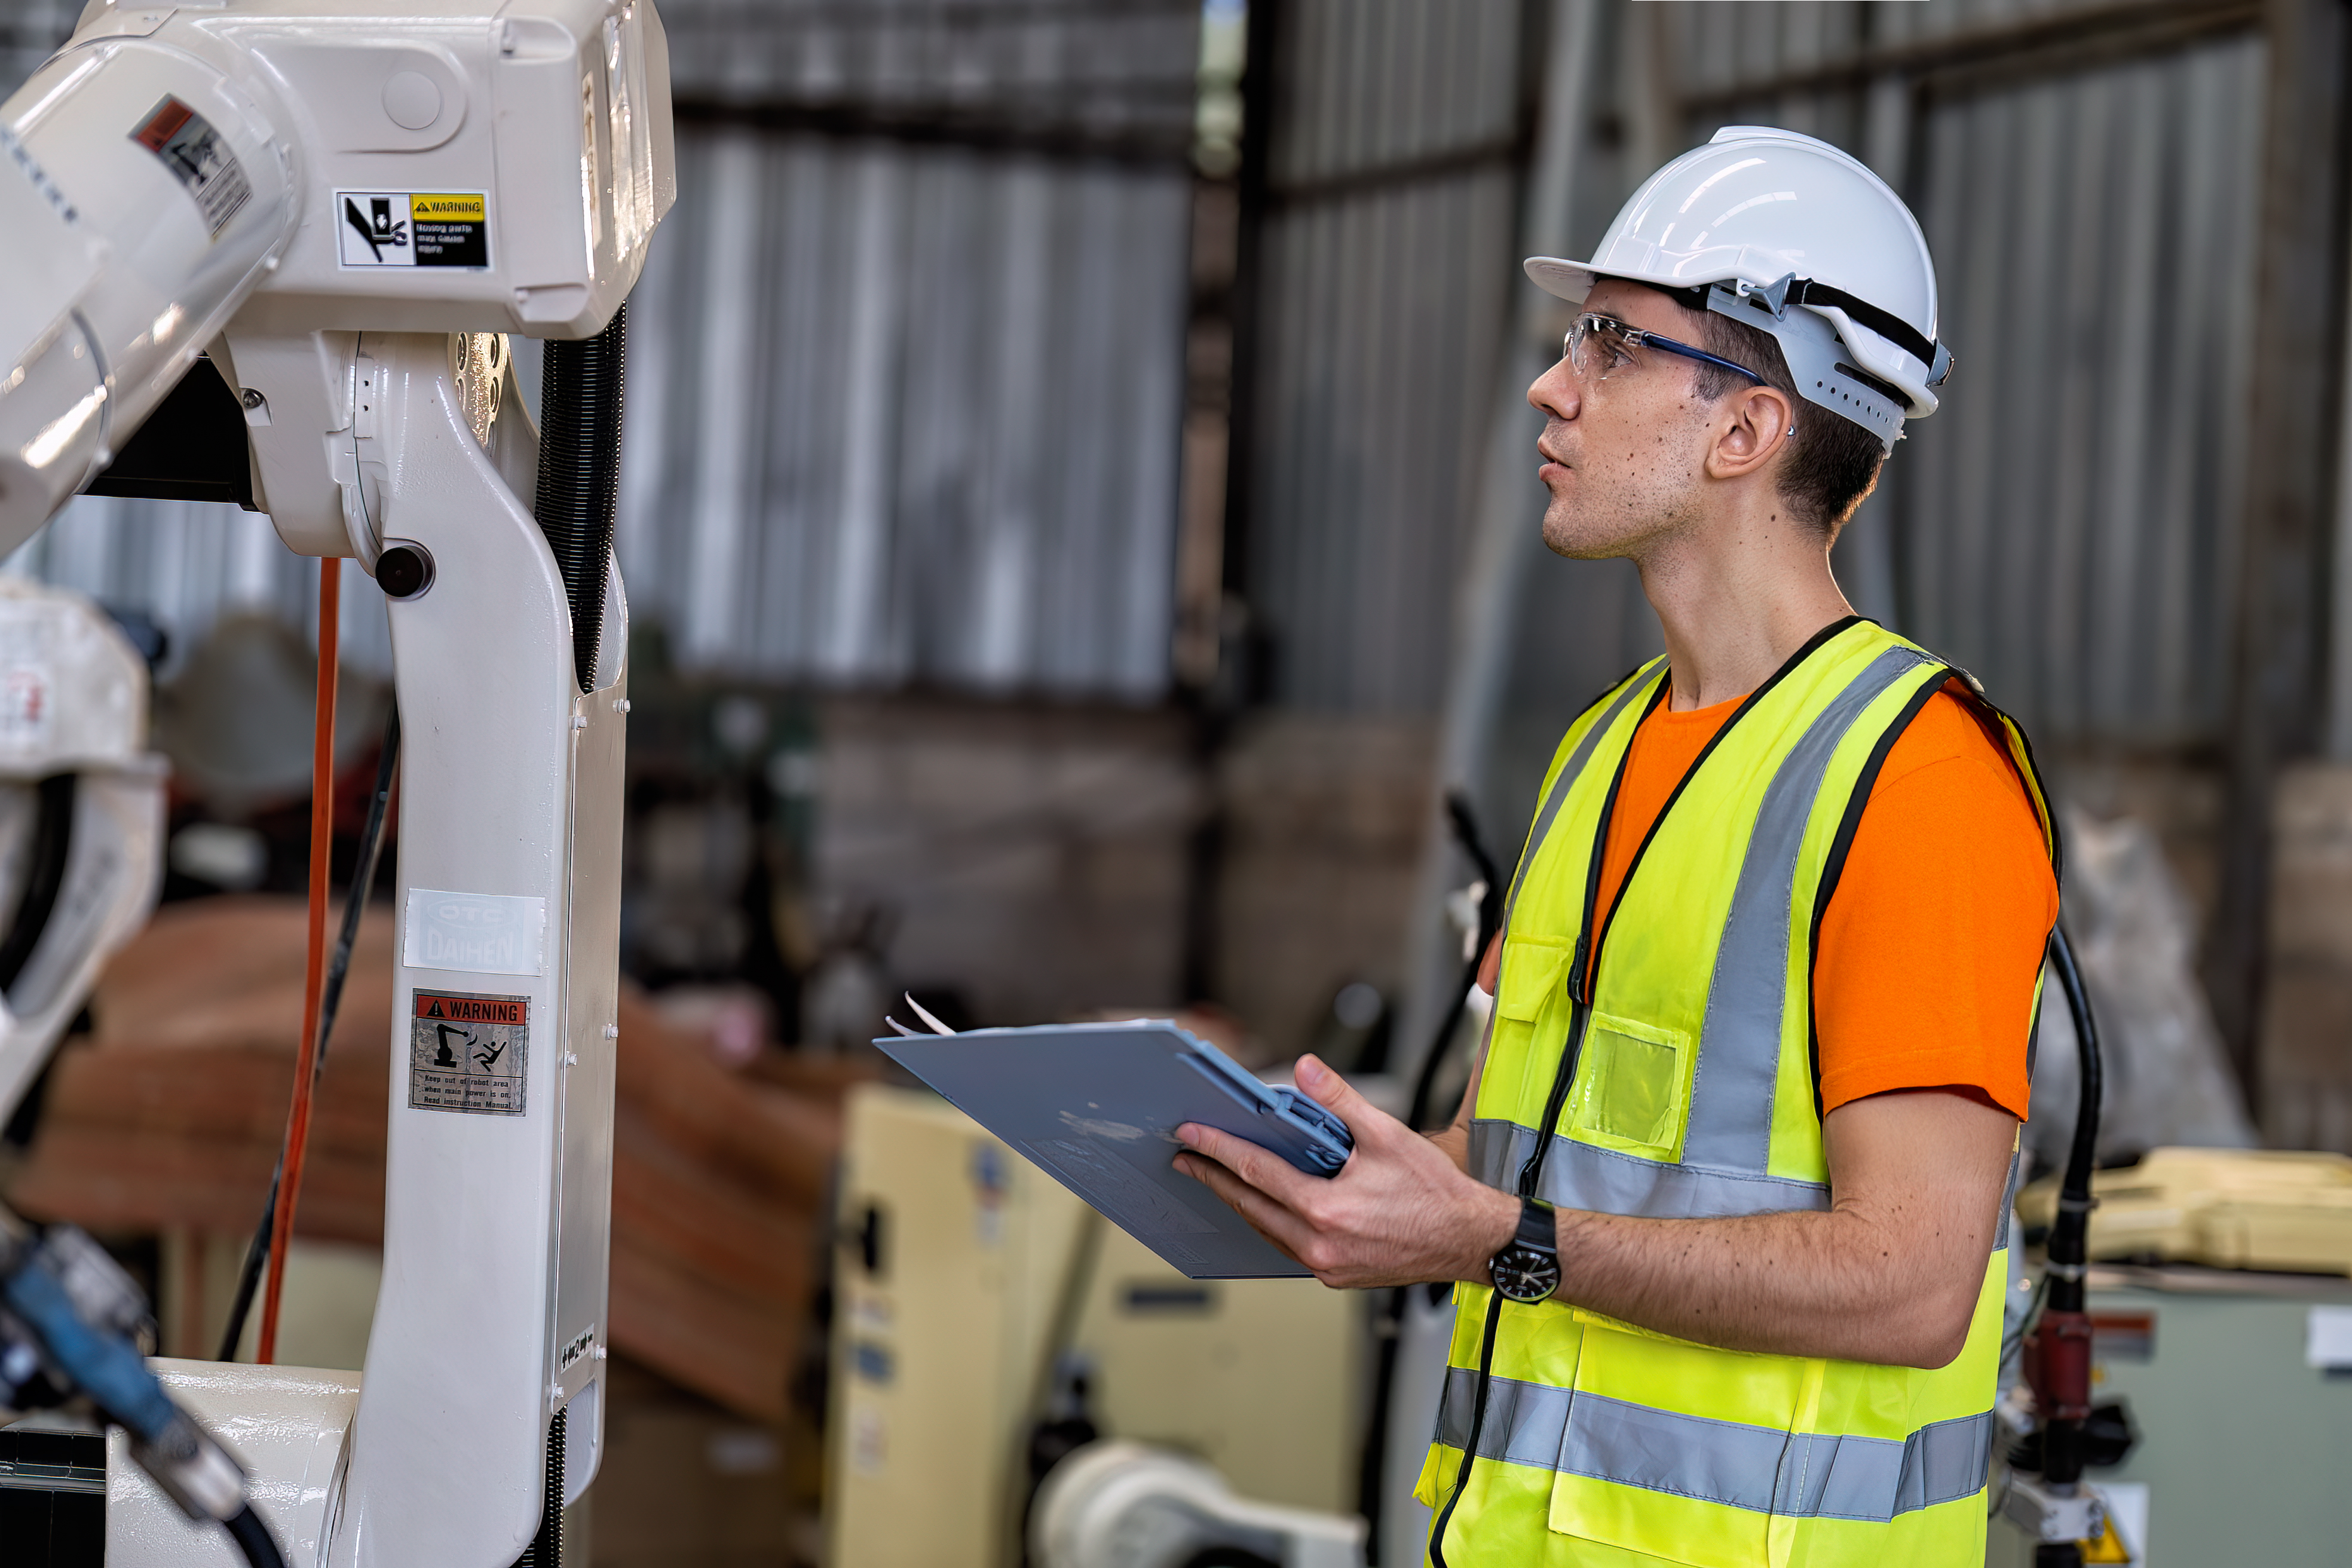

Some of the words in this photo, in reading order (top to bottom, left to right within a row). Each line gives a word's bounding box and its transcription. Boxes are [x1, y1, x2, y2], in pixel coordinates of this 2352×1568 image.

[430, 201, 482, 213] WARNING
[426, 924, 514, 966] DAIHEN
[449, 1000, 518, 1022] WARNING
[424, 1074, 441, 1083] Keep
[445, 1076, 456, 1085] out
[470, 1077, 489, 1086] robot
[424, 1085, 441, 1094] when
[445, 1087, 461, 1095] main
[424, 1096, 440, 1104] Read
